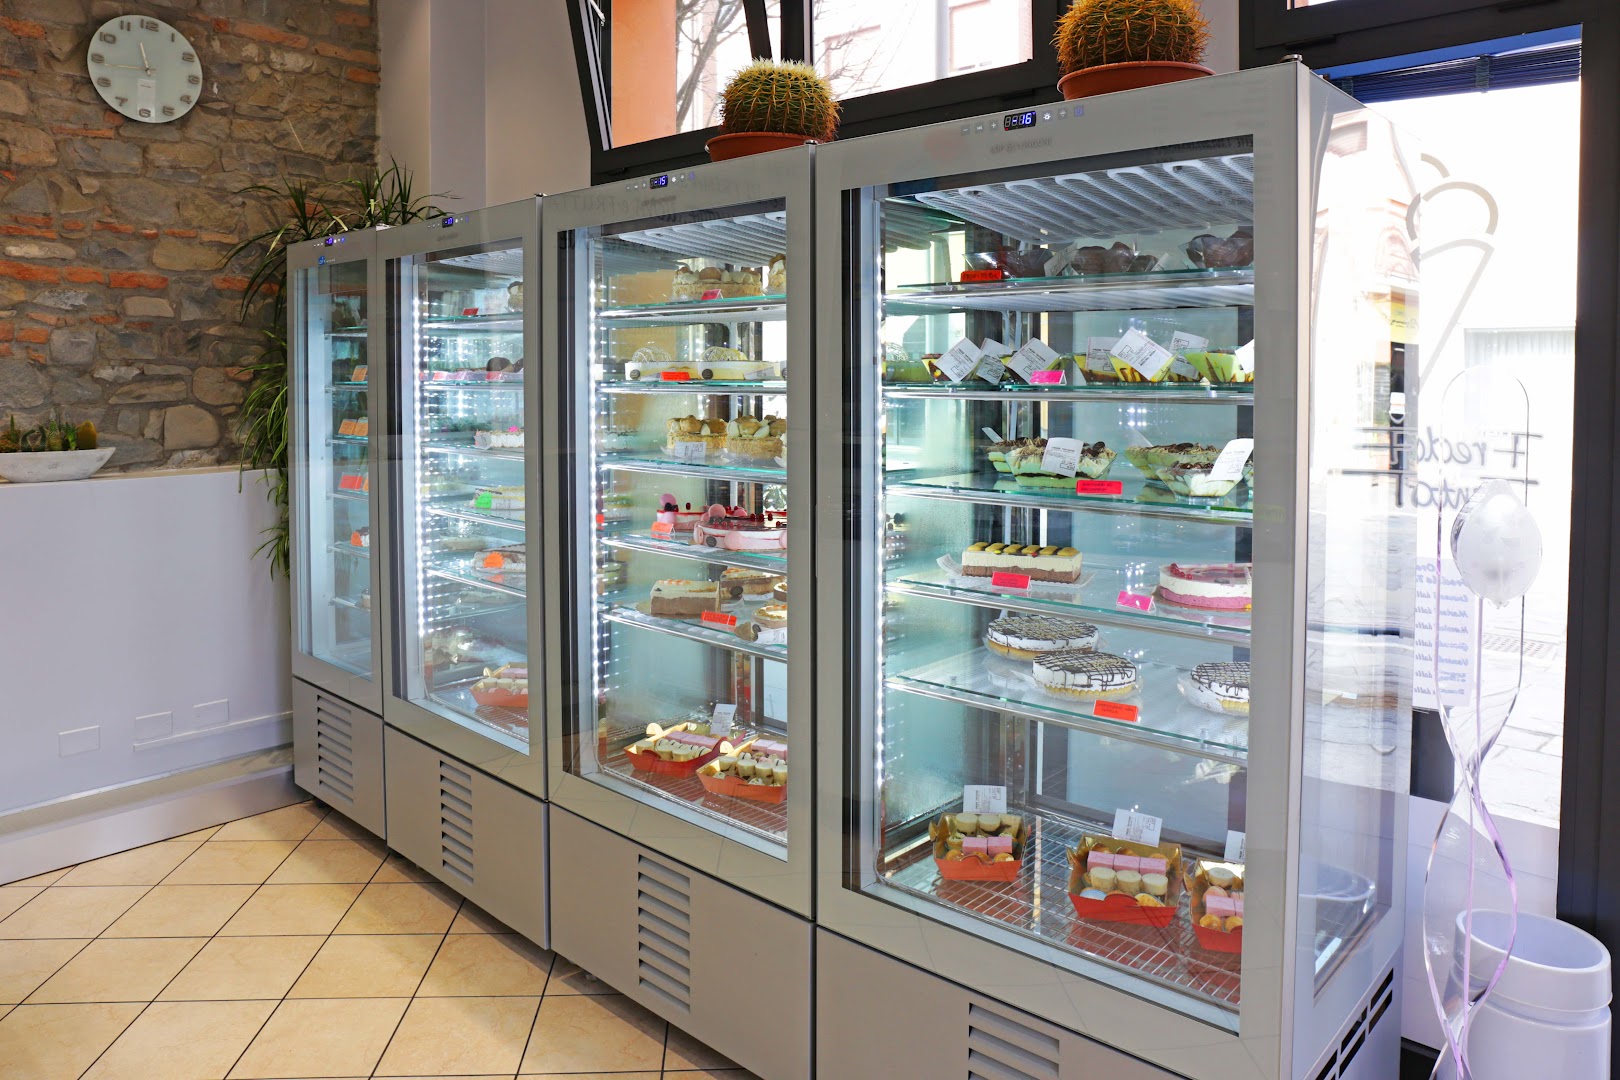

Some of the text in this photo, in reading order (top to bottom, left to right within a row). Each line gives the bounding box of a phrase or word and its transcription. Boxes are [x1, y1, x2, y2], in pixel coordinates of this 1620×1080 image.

[120, 20, 131, 31] 11
[140, 19, 159, 32] 12
[100, 32, 117, 44] 10
[182, 52, 195, 62] 2
[188, 74, 200, 84] 3
[115, 96, 128, 106] 7
[139, 108, 151, 118] 6
[163, 106, 175, 116] 5
